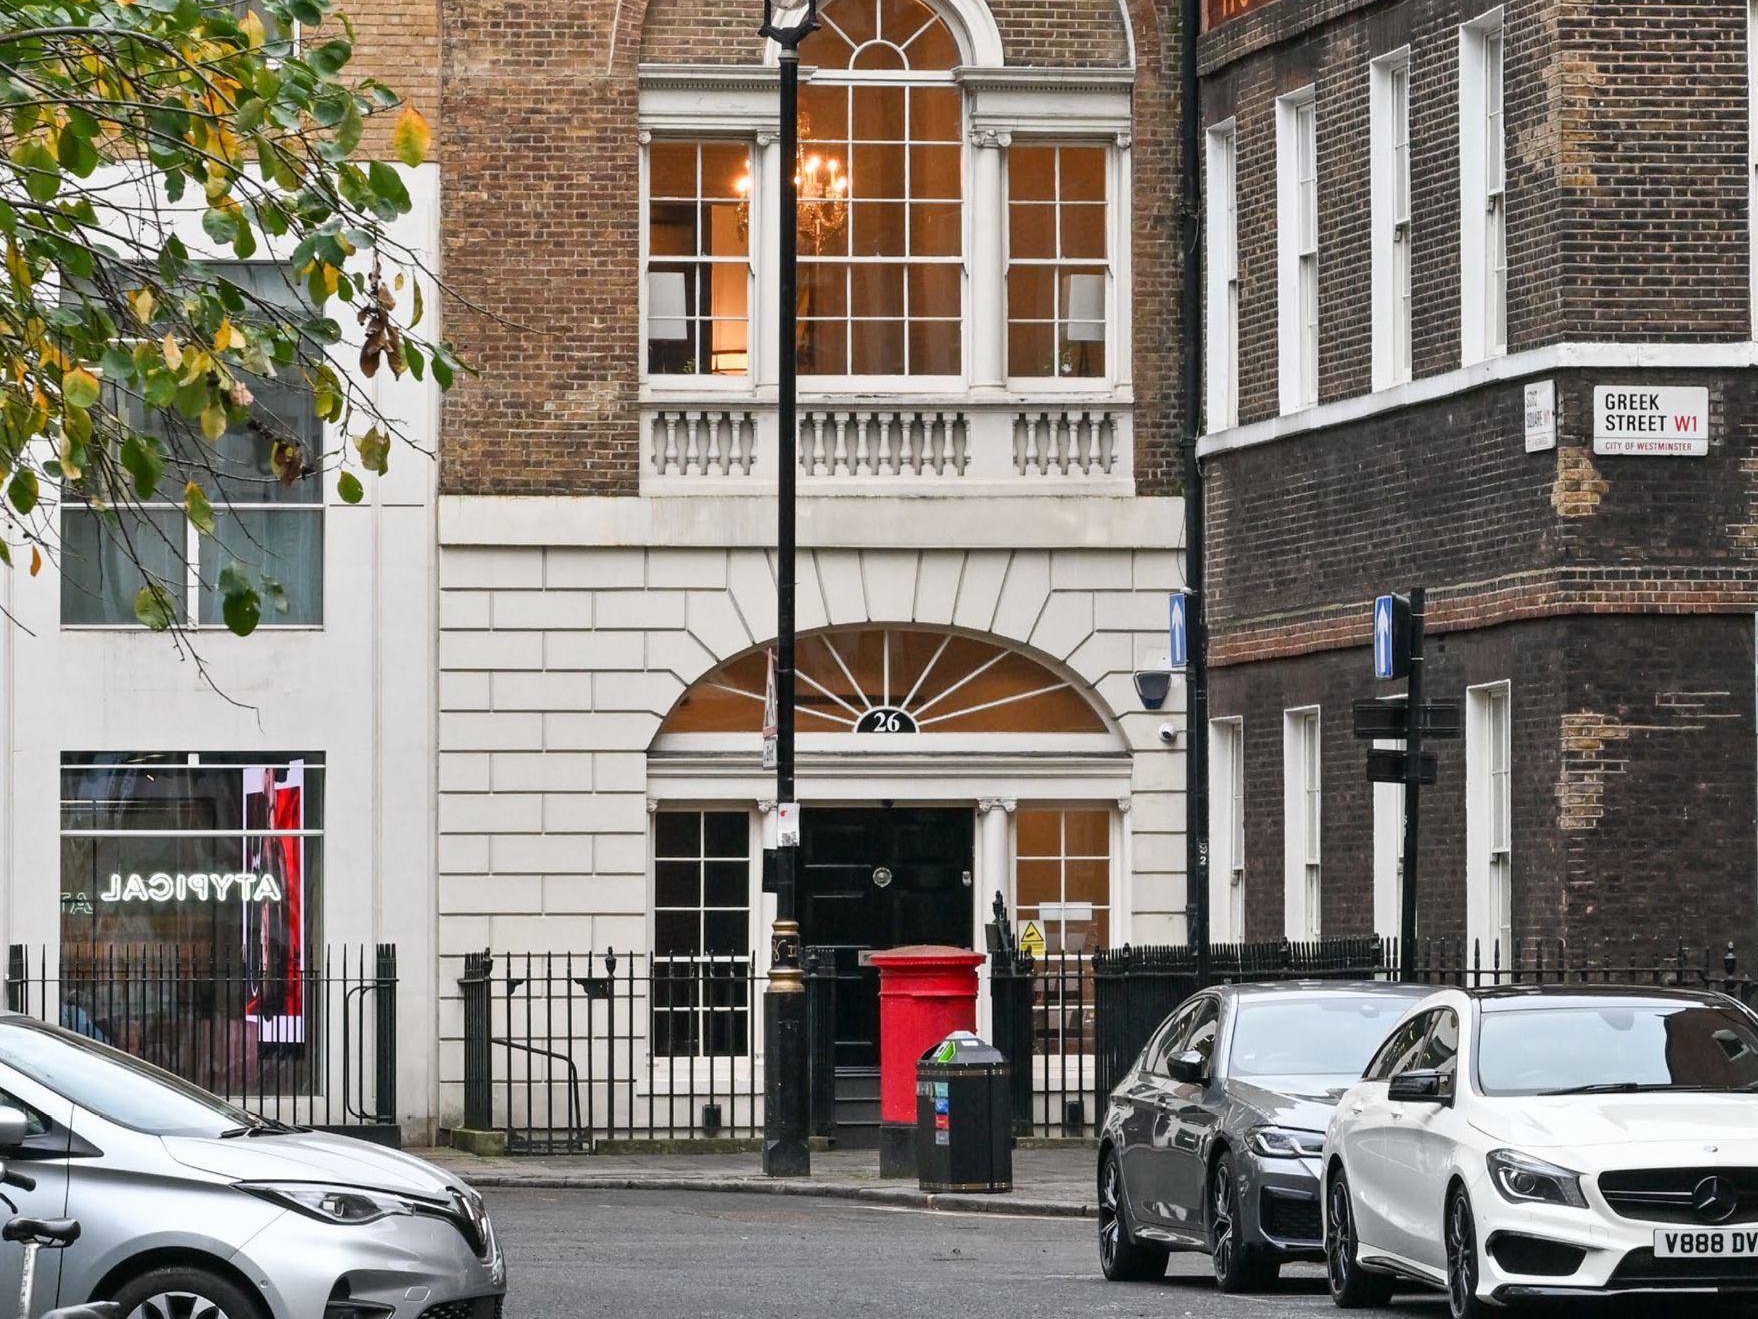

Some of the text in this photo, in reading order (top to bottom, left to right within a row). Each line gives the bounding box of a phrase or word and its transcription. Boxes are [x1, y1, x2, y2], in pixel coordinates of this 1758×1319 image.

[1605, 393, 1659, 410] GREEK
[1605, 414, 1697, 432] STREET W1
[1605, 442, 1692, 451] CITY OF WESTMINSTER
[873, 711, 900, 732] 26
[1665, 1233, 1724, 1253] V888
